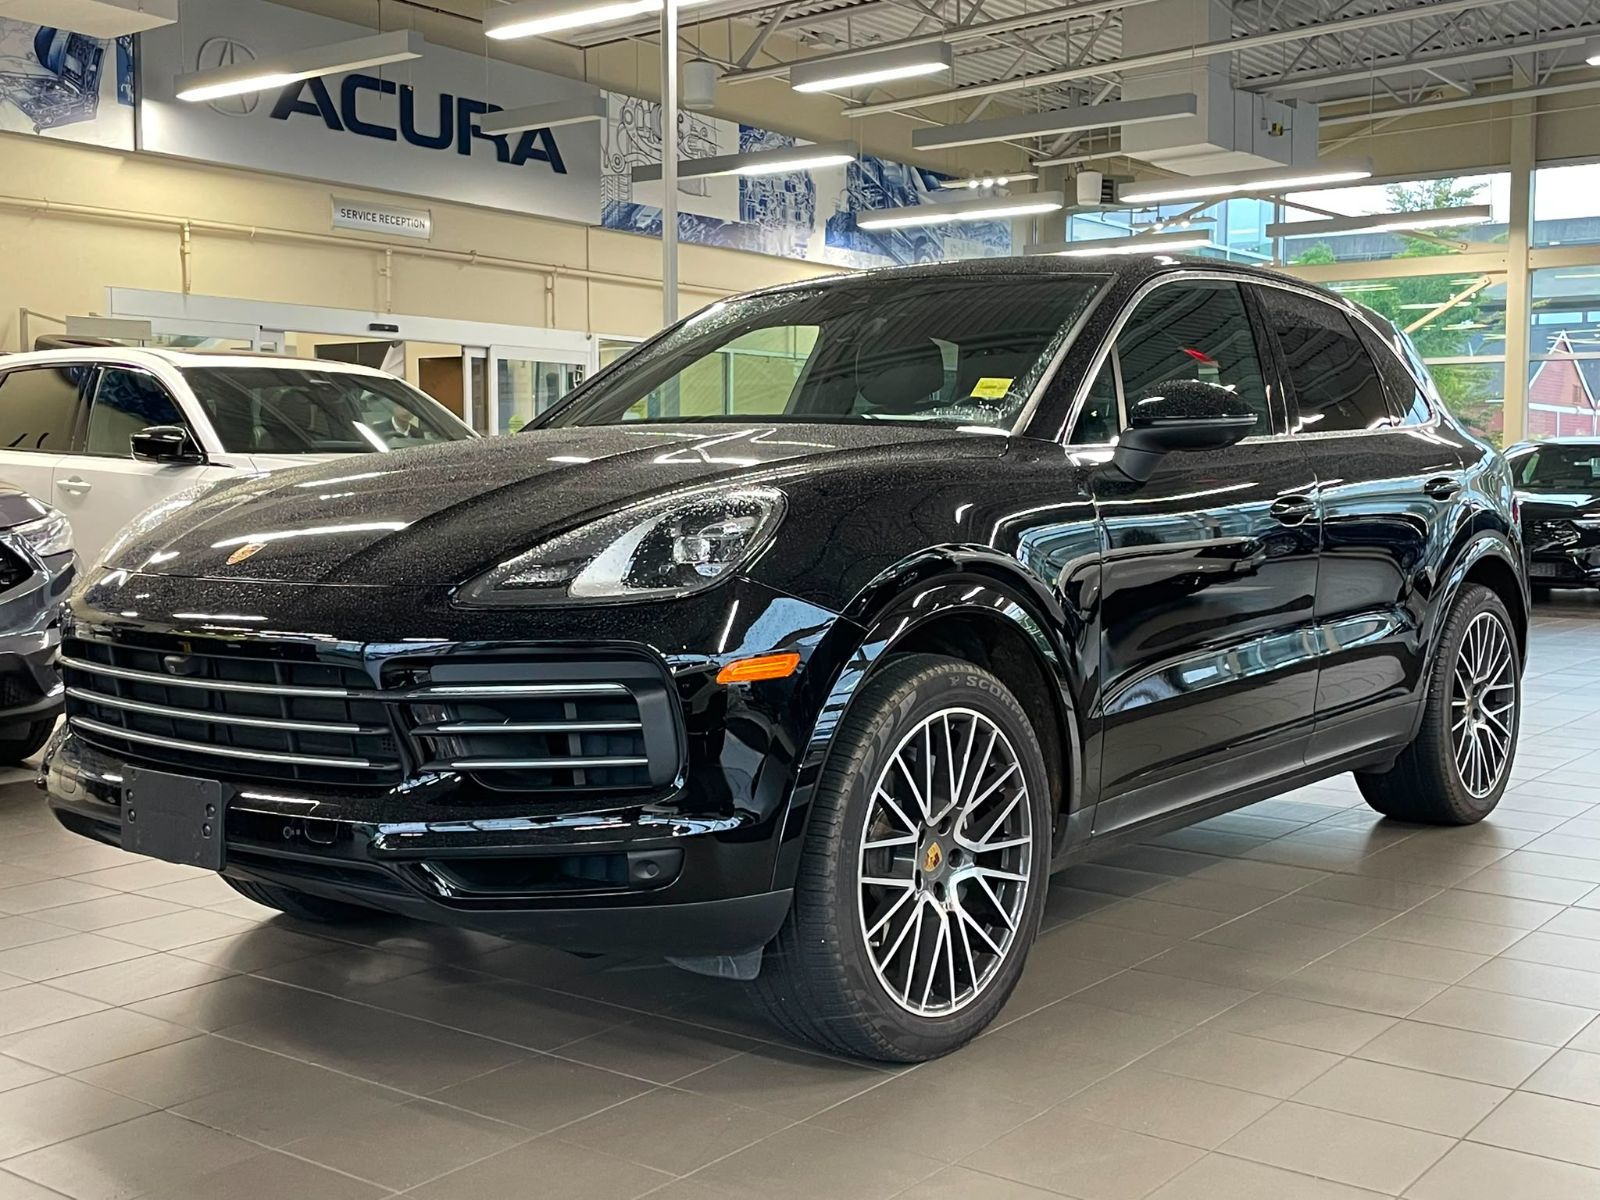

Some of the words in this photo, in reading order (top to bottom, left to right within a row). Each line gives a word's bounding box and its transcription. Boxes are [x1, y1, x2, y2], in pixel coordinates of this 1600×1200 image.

[270, 74, 567, 174] ACURA
[340, 208, 377, 222] SERVICE
[379, 214, 425, 229] RECEPTION
